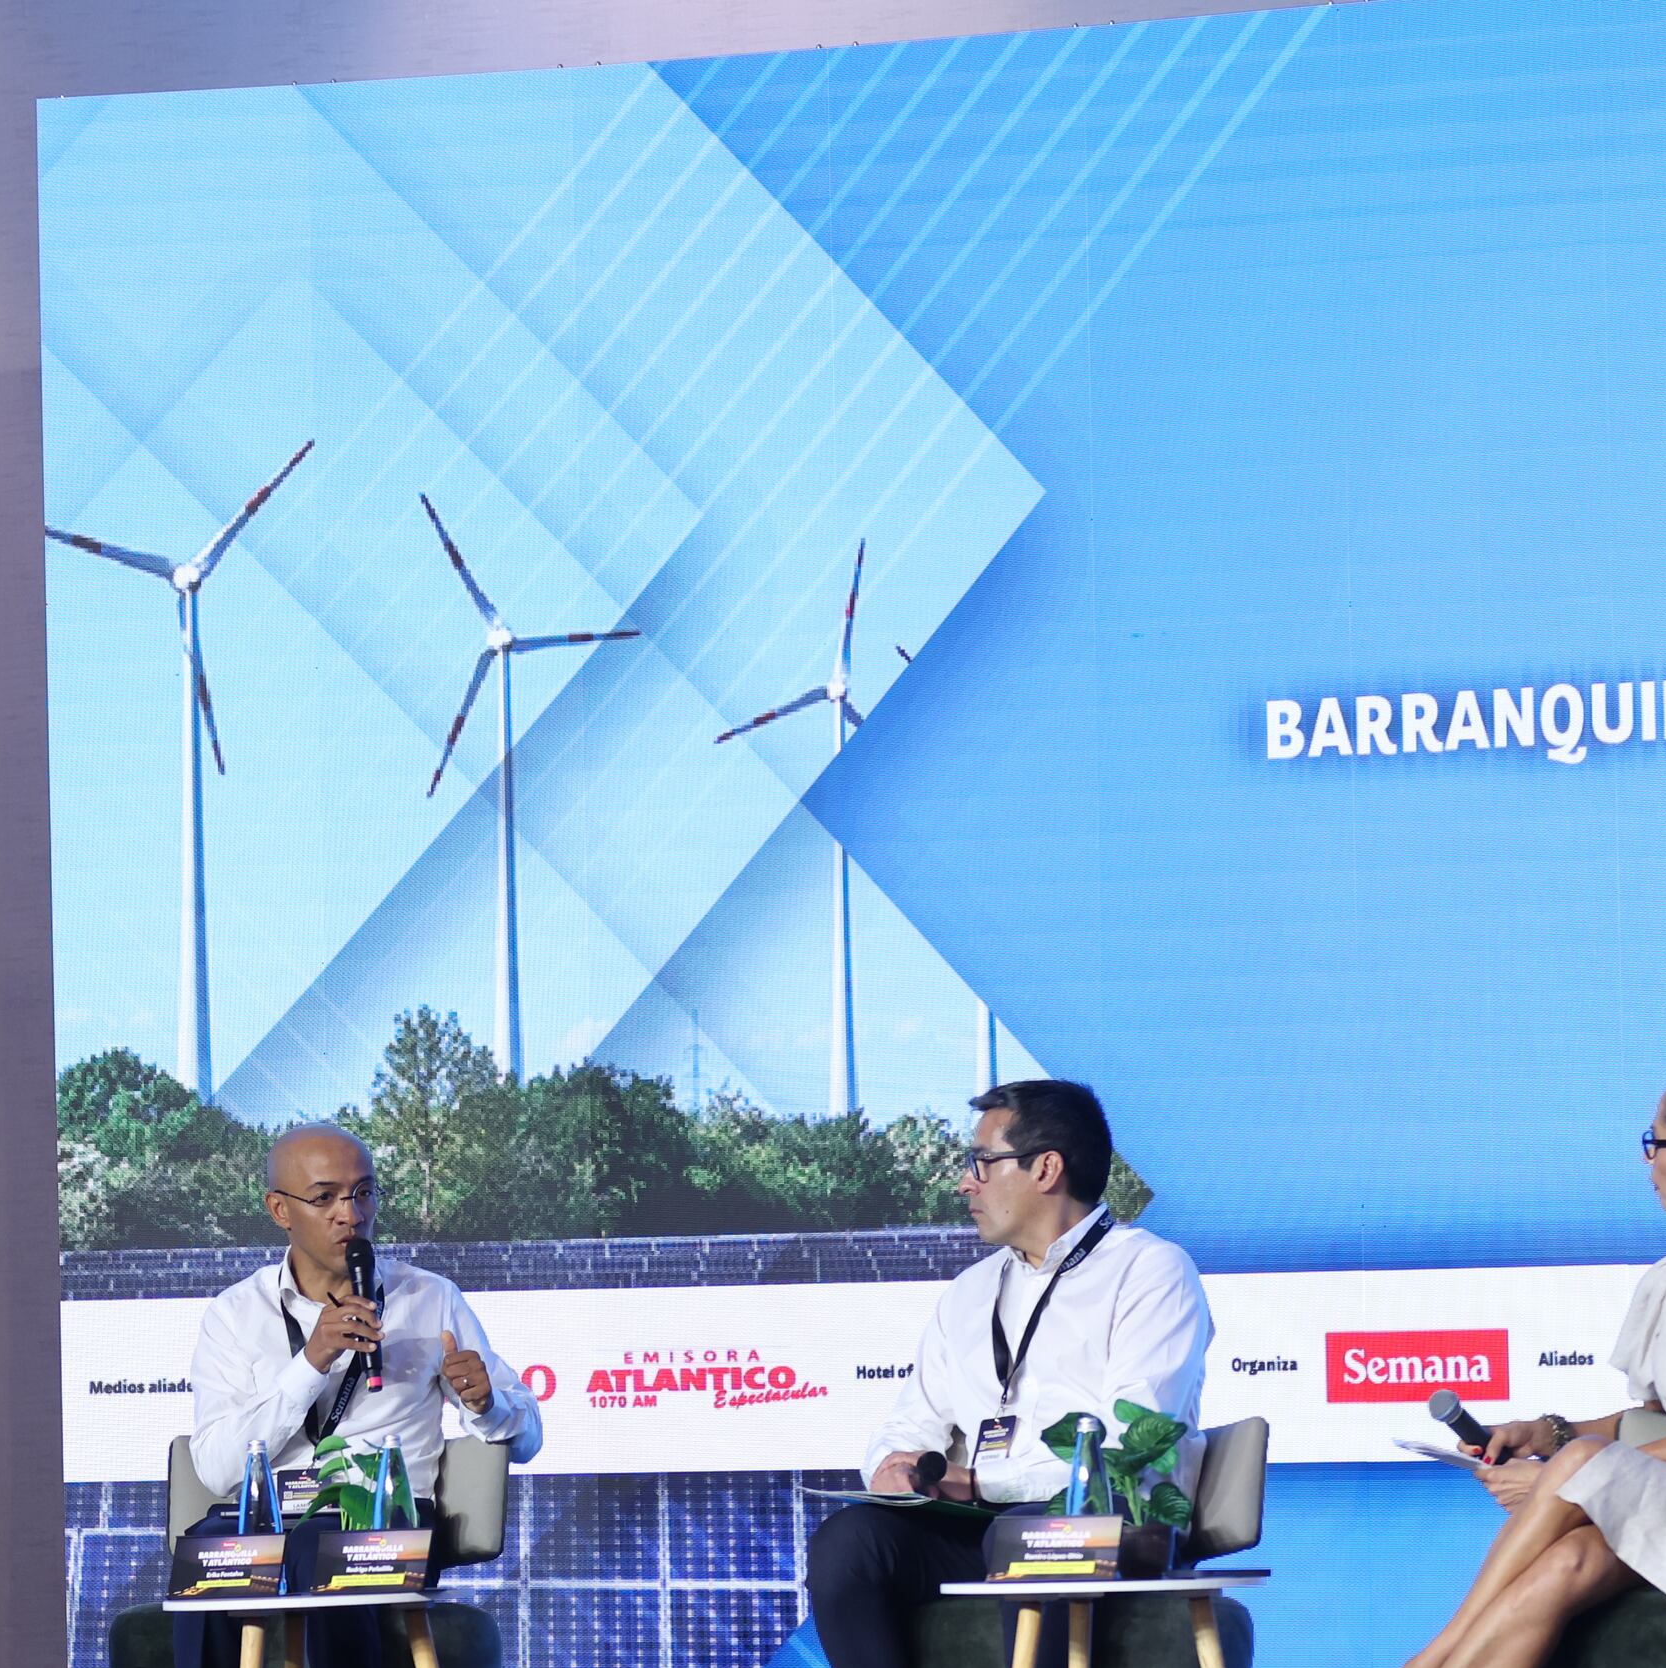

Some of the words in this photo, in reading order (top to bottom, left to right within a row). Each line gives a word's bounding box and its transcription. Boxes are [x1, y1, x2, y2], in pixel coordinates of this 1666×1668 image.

[623, 1349, 761, 1364] EMISORA
[1538, 1351, 1594, 1368] Aliados
[856, 1364, 895, 1380] Hotel
[1232, 1358, 1298, 1375] Organiza
[1343, 1347, 1492, 1385] Semana
[89, 1379, 145, 1394] Medios
[586, 1366, 796, 1393] ATLANTICO
[330, 1375, 356, 1424] Semana
[590, 1395, 627, 1408] 1070
[632, 1394, 658, 1408] AM
[713, 1382, 828, 1409] Espectacular
